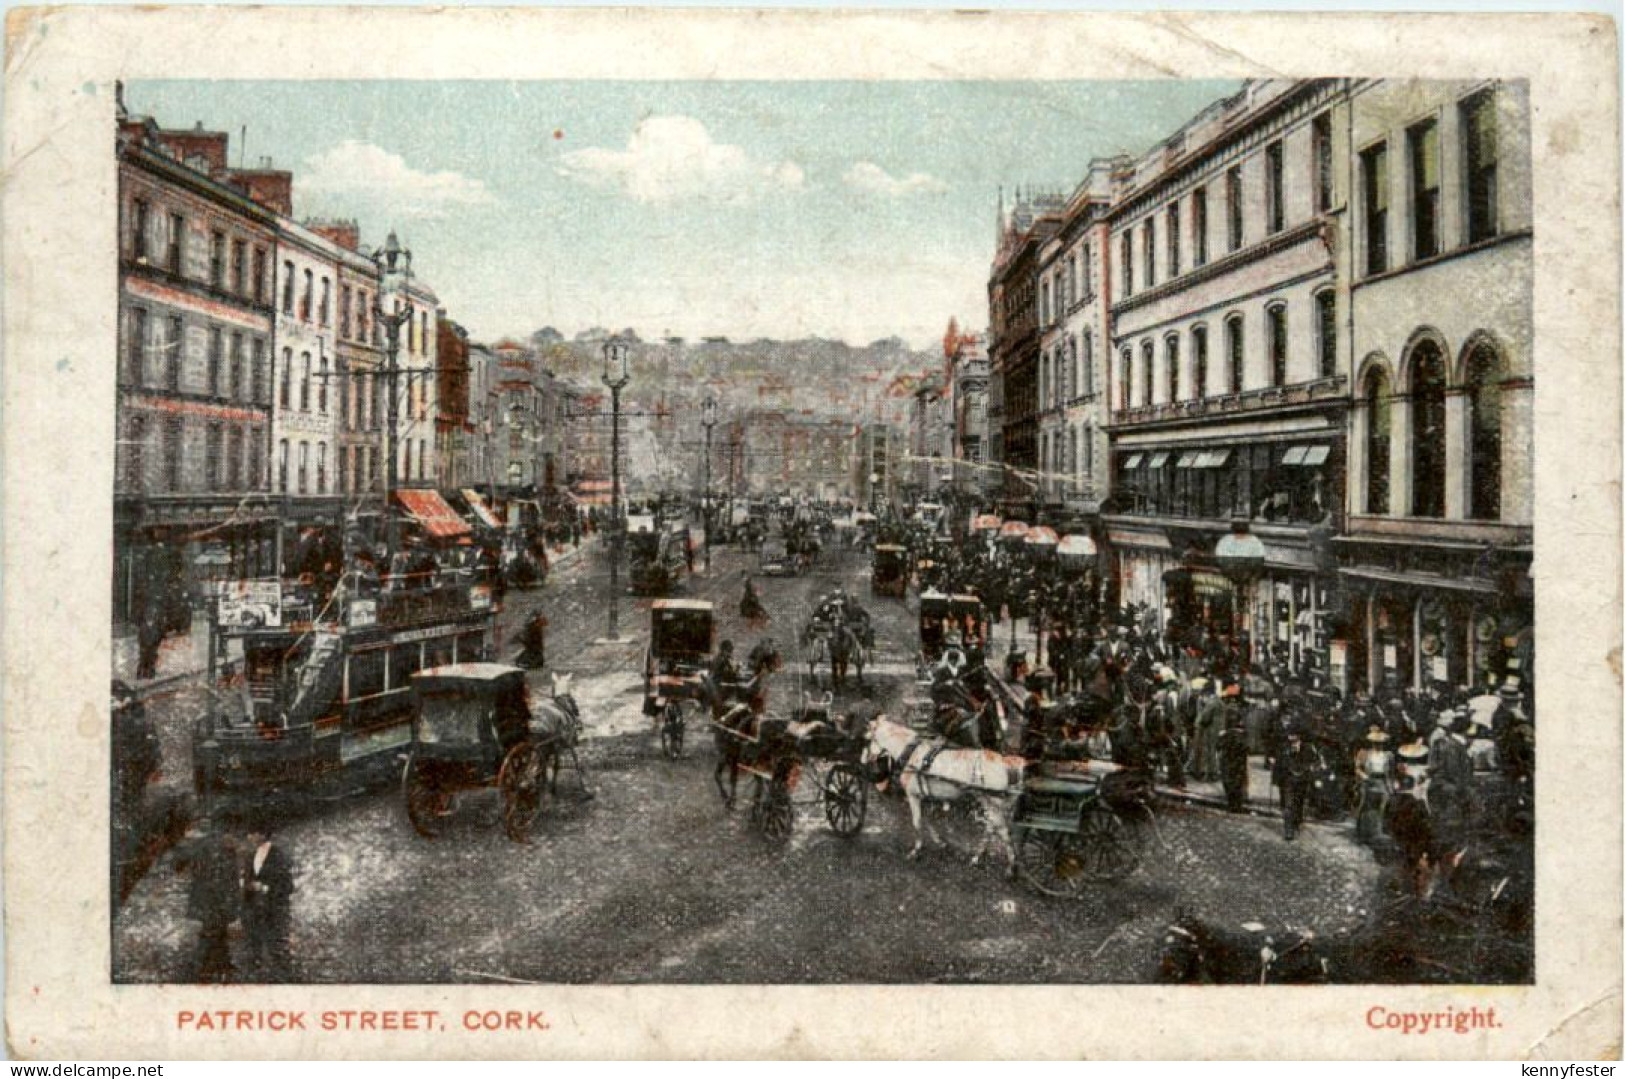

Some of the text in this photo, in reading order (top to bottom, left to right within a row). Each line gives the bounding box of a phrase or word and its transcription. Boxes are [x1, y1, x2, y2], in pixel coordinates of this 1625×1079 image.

[177, 1010, 551, 1032] PATRICK STREET, CORK.
[1366, 1006, 1503, 1034] Copyright.
